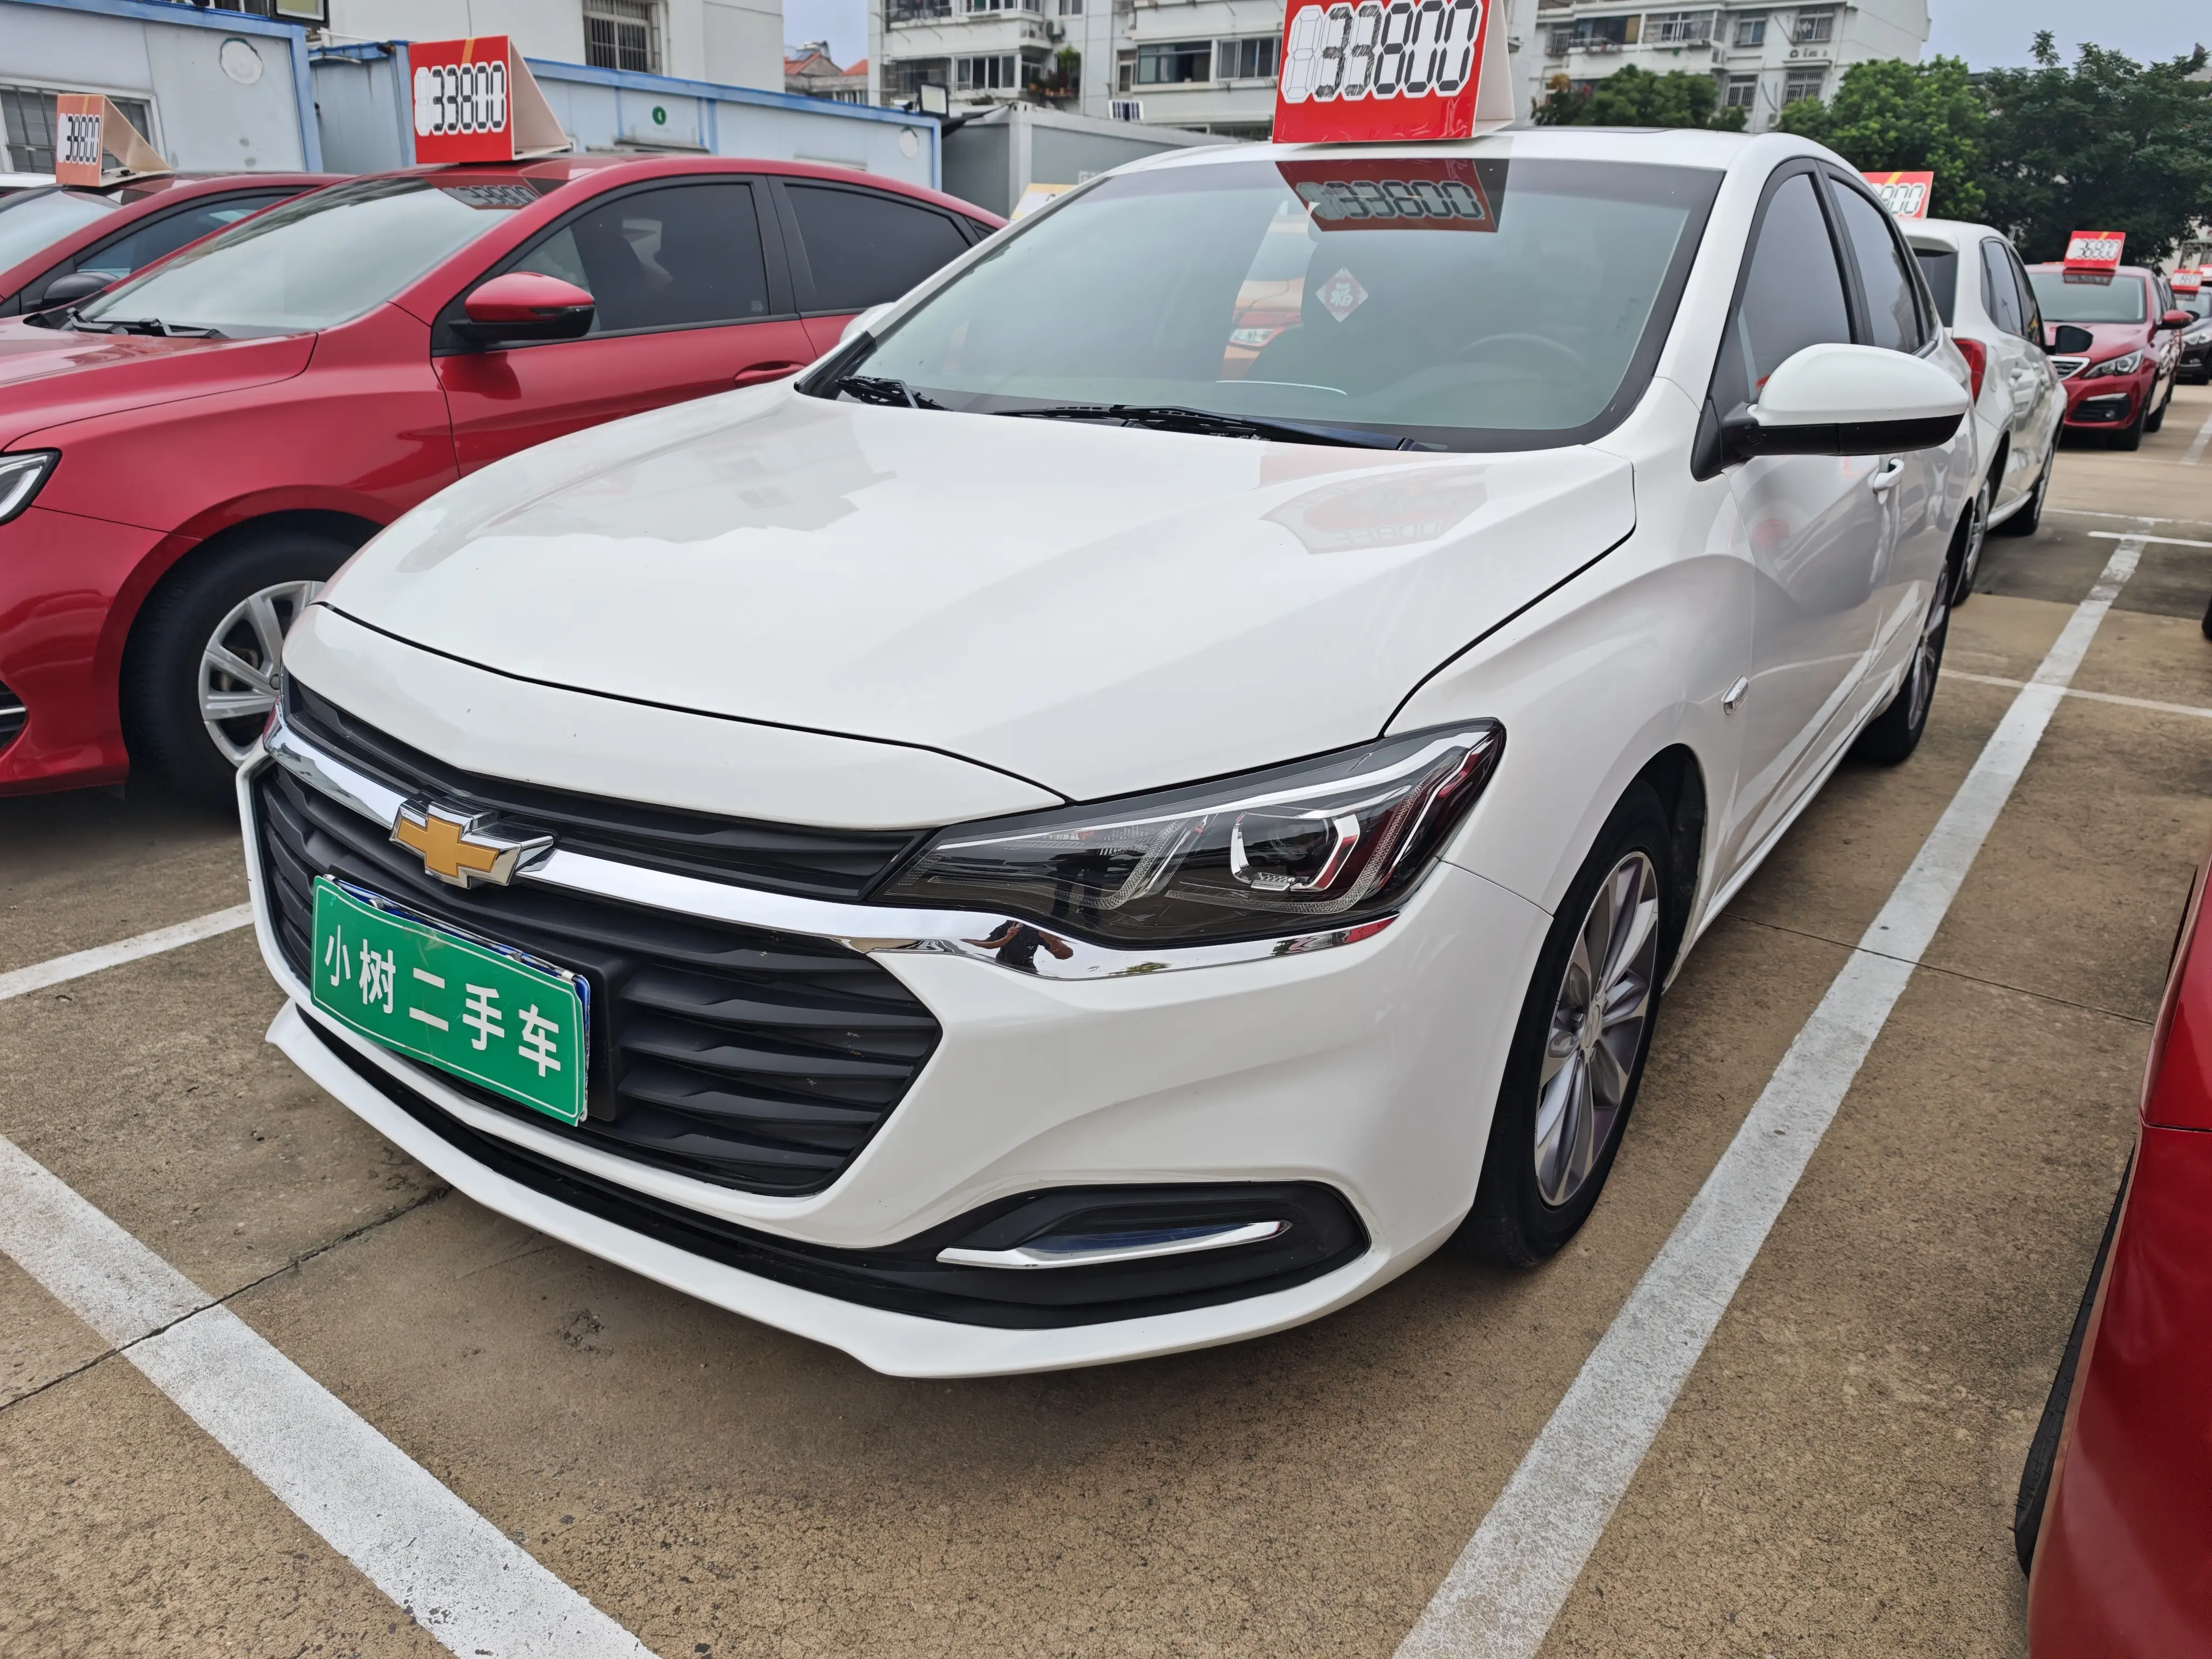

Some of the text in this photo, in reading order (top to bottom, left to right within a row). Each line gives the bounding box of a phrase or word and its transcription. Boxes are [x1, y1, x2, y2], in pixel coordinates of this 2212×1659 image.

[1314, 0, 1479, 99] 33800
[432, 64, 504, 132] 33800
[1880, 185, 1924, 213] 800
[325, 925, 561, 1077] 小树二手车
